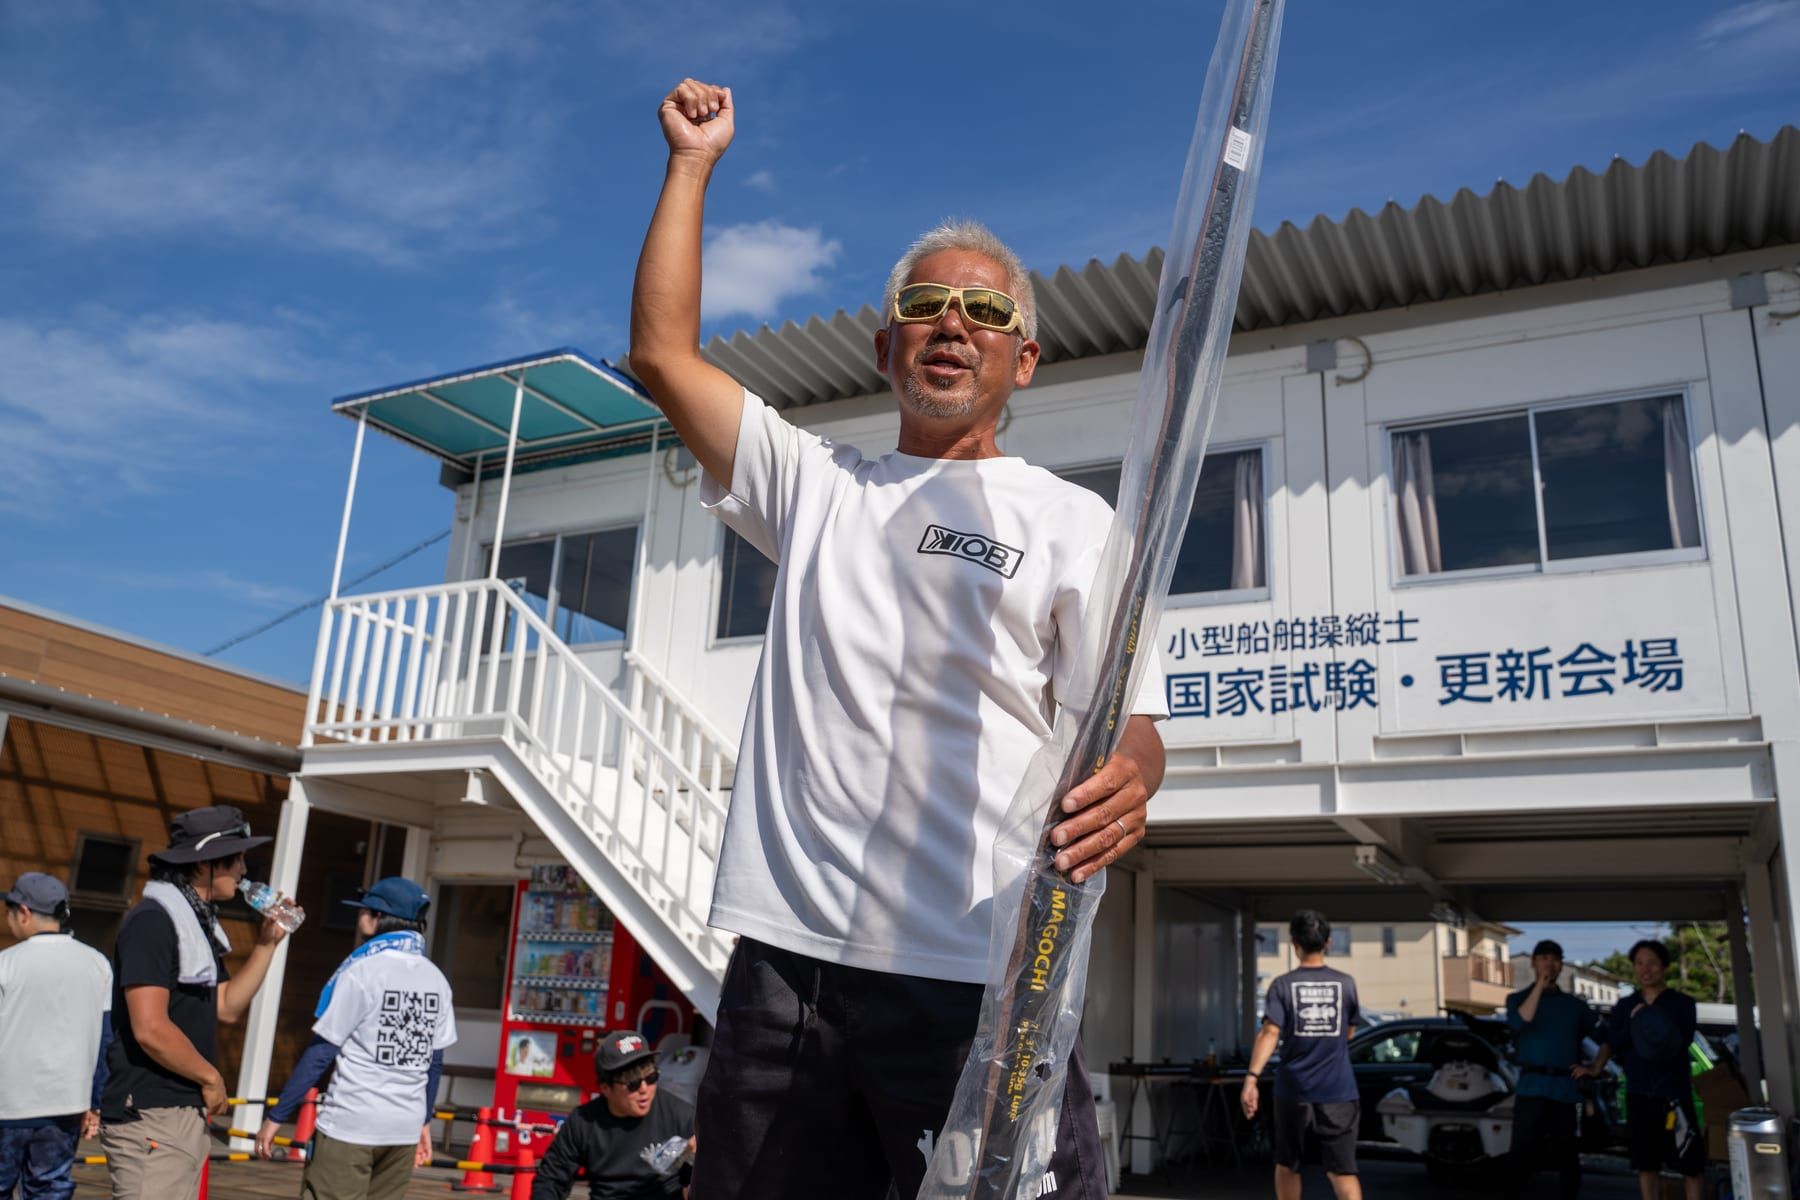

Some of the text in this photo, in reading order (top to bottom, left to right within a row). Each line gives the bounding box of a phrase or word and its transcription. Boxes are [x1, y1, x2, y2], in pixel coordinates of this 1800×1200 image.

[1168, 610, 1420, 659] 小型船舶操縦士
[1166, 638, 1684, 720] 国家試験・更新会場
